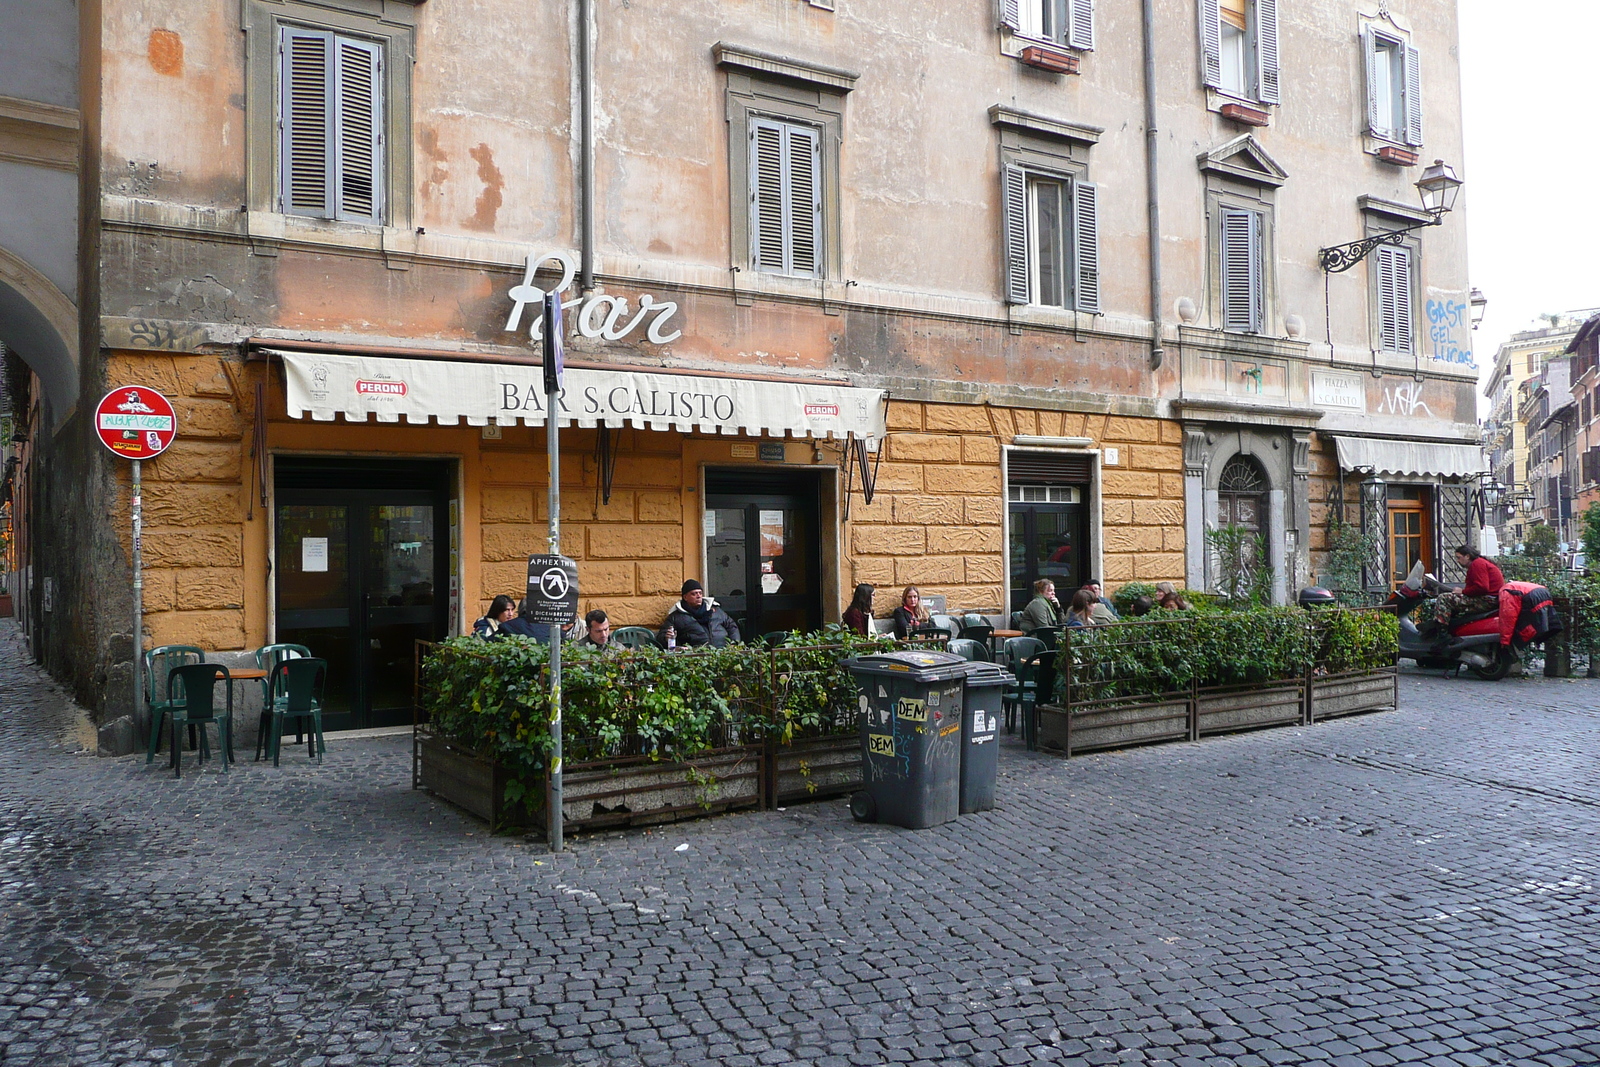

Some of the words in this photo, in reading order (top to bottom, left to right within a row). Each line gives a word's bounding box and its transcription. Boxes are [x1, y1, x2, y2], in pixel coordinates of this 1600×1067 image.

[504, 250, 681, 344] Bar
[360, 383, 403, 393] PERONI
[1325, 378, 1348, 388] PIAZZA
[500, 383, 571, 412] BAR
[806, 406, 837, 414] PERONI
[1109, 450, 1115, 462] 5
[898, 700, 926, 719] DEM
[869, 736, 894, 753] DEM
